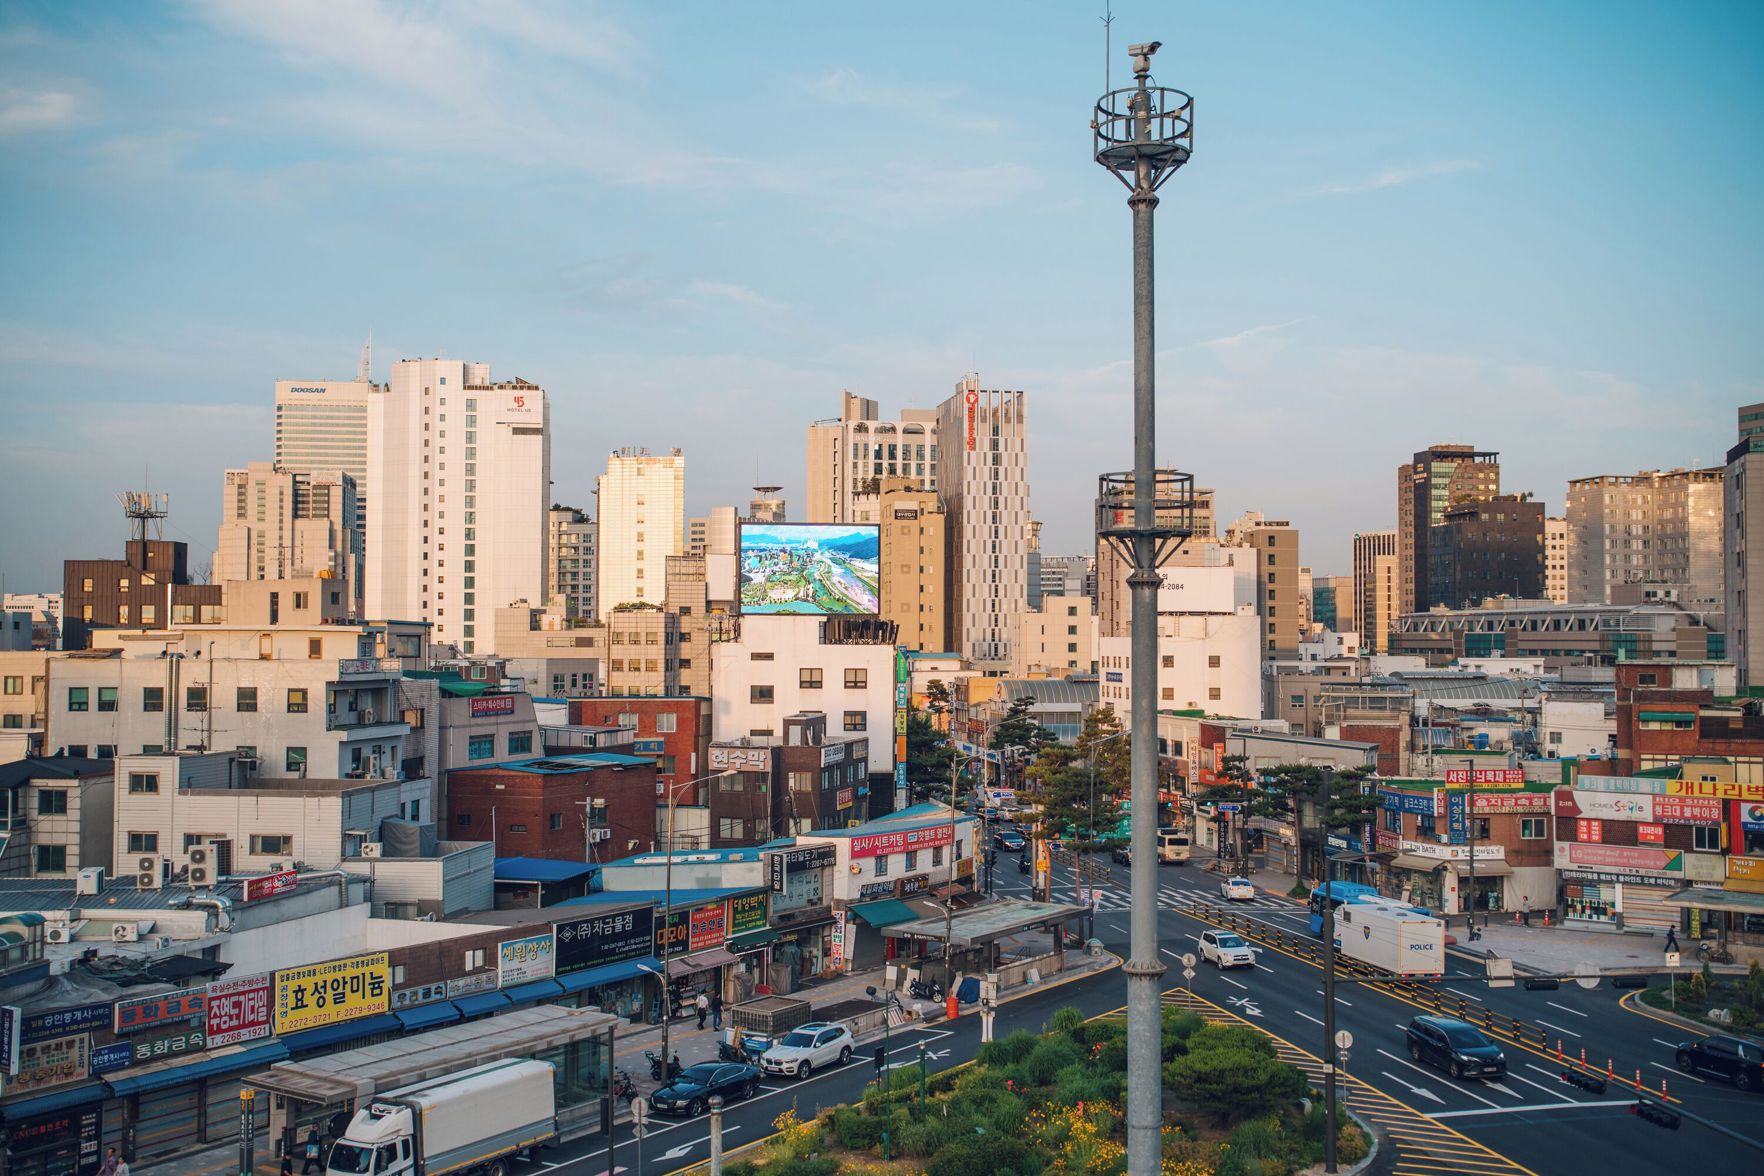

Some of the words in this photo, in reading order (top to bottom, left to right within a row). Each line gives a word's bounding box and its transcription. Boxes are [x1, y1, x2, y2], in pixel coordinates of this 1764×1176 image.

[711, 750, 767, 770] 현수막
[1614, 800, 1644, 814] Style
[1685, 798, 1719, 806] SINK
[1451, 796, 1462, 831] 이상기획
[853, 834, 904, 851] 실사/시트커팅
[1572, 849, 1583, 858] LG
[502, 939, 551, 963] 세원상사
[290, 971, 385, 1011] 효성알미늄
[210, 989, 267, 1031] 주영도기타일
[136, 1032, 204, 1059] 동화금속
